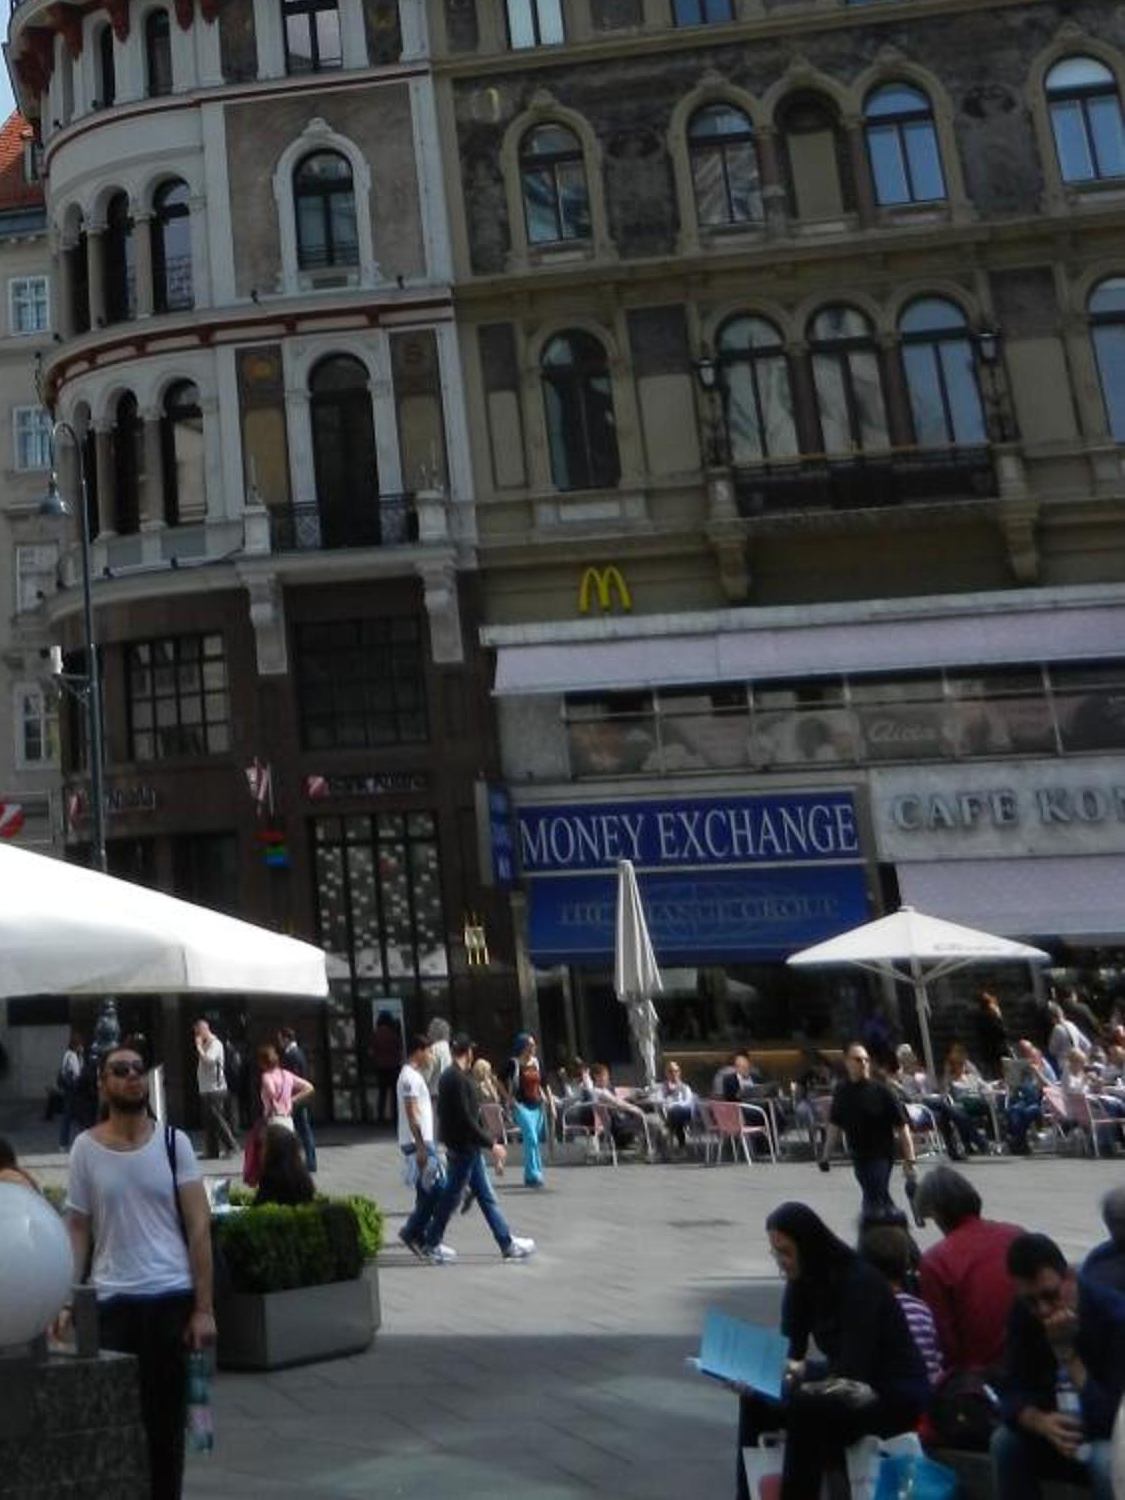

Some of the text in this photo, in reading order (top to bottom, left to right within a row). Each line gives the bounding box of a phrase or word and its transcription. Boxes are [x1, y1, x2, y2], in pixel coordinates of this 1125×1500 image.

[520, 813, 645, 864] MONEY
[657, 803, 859, 859] EXCHANGE
[892, 789, 1018, 831] CAFE
